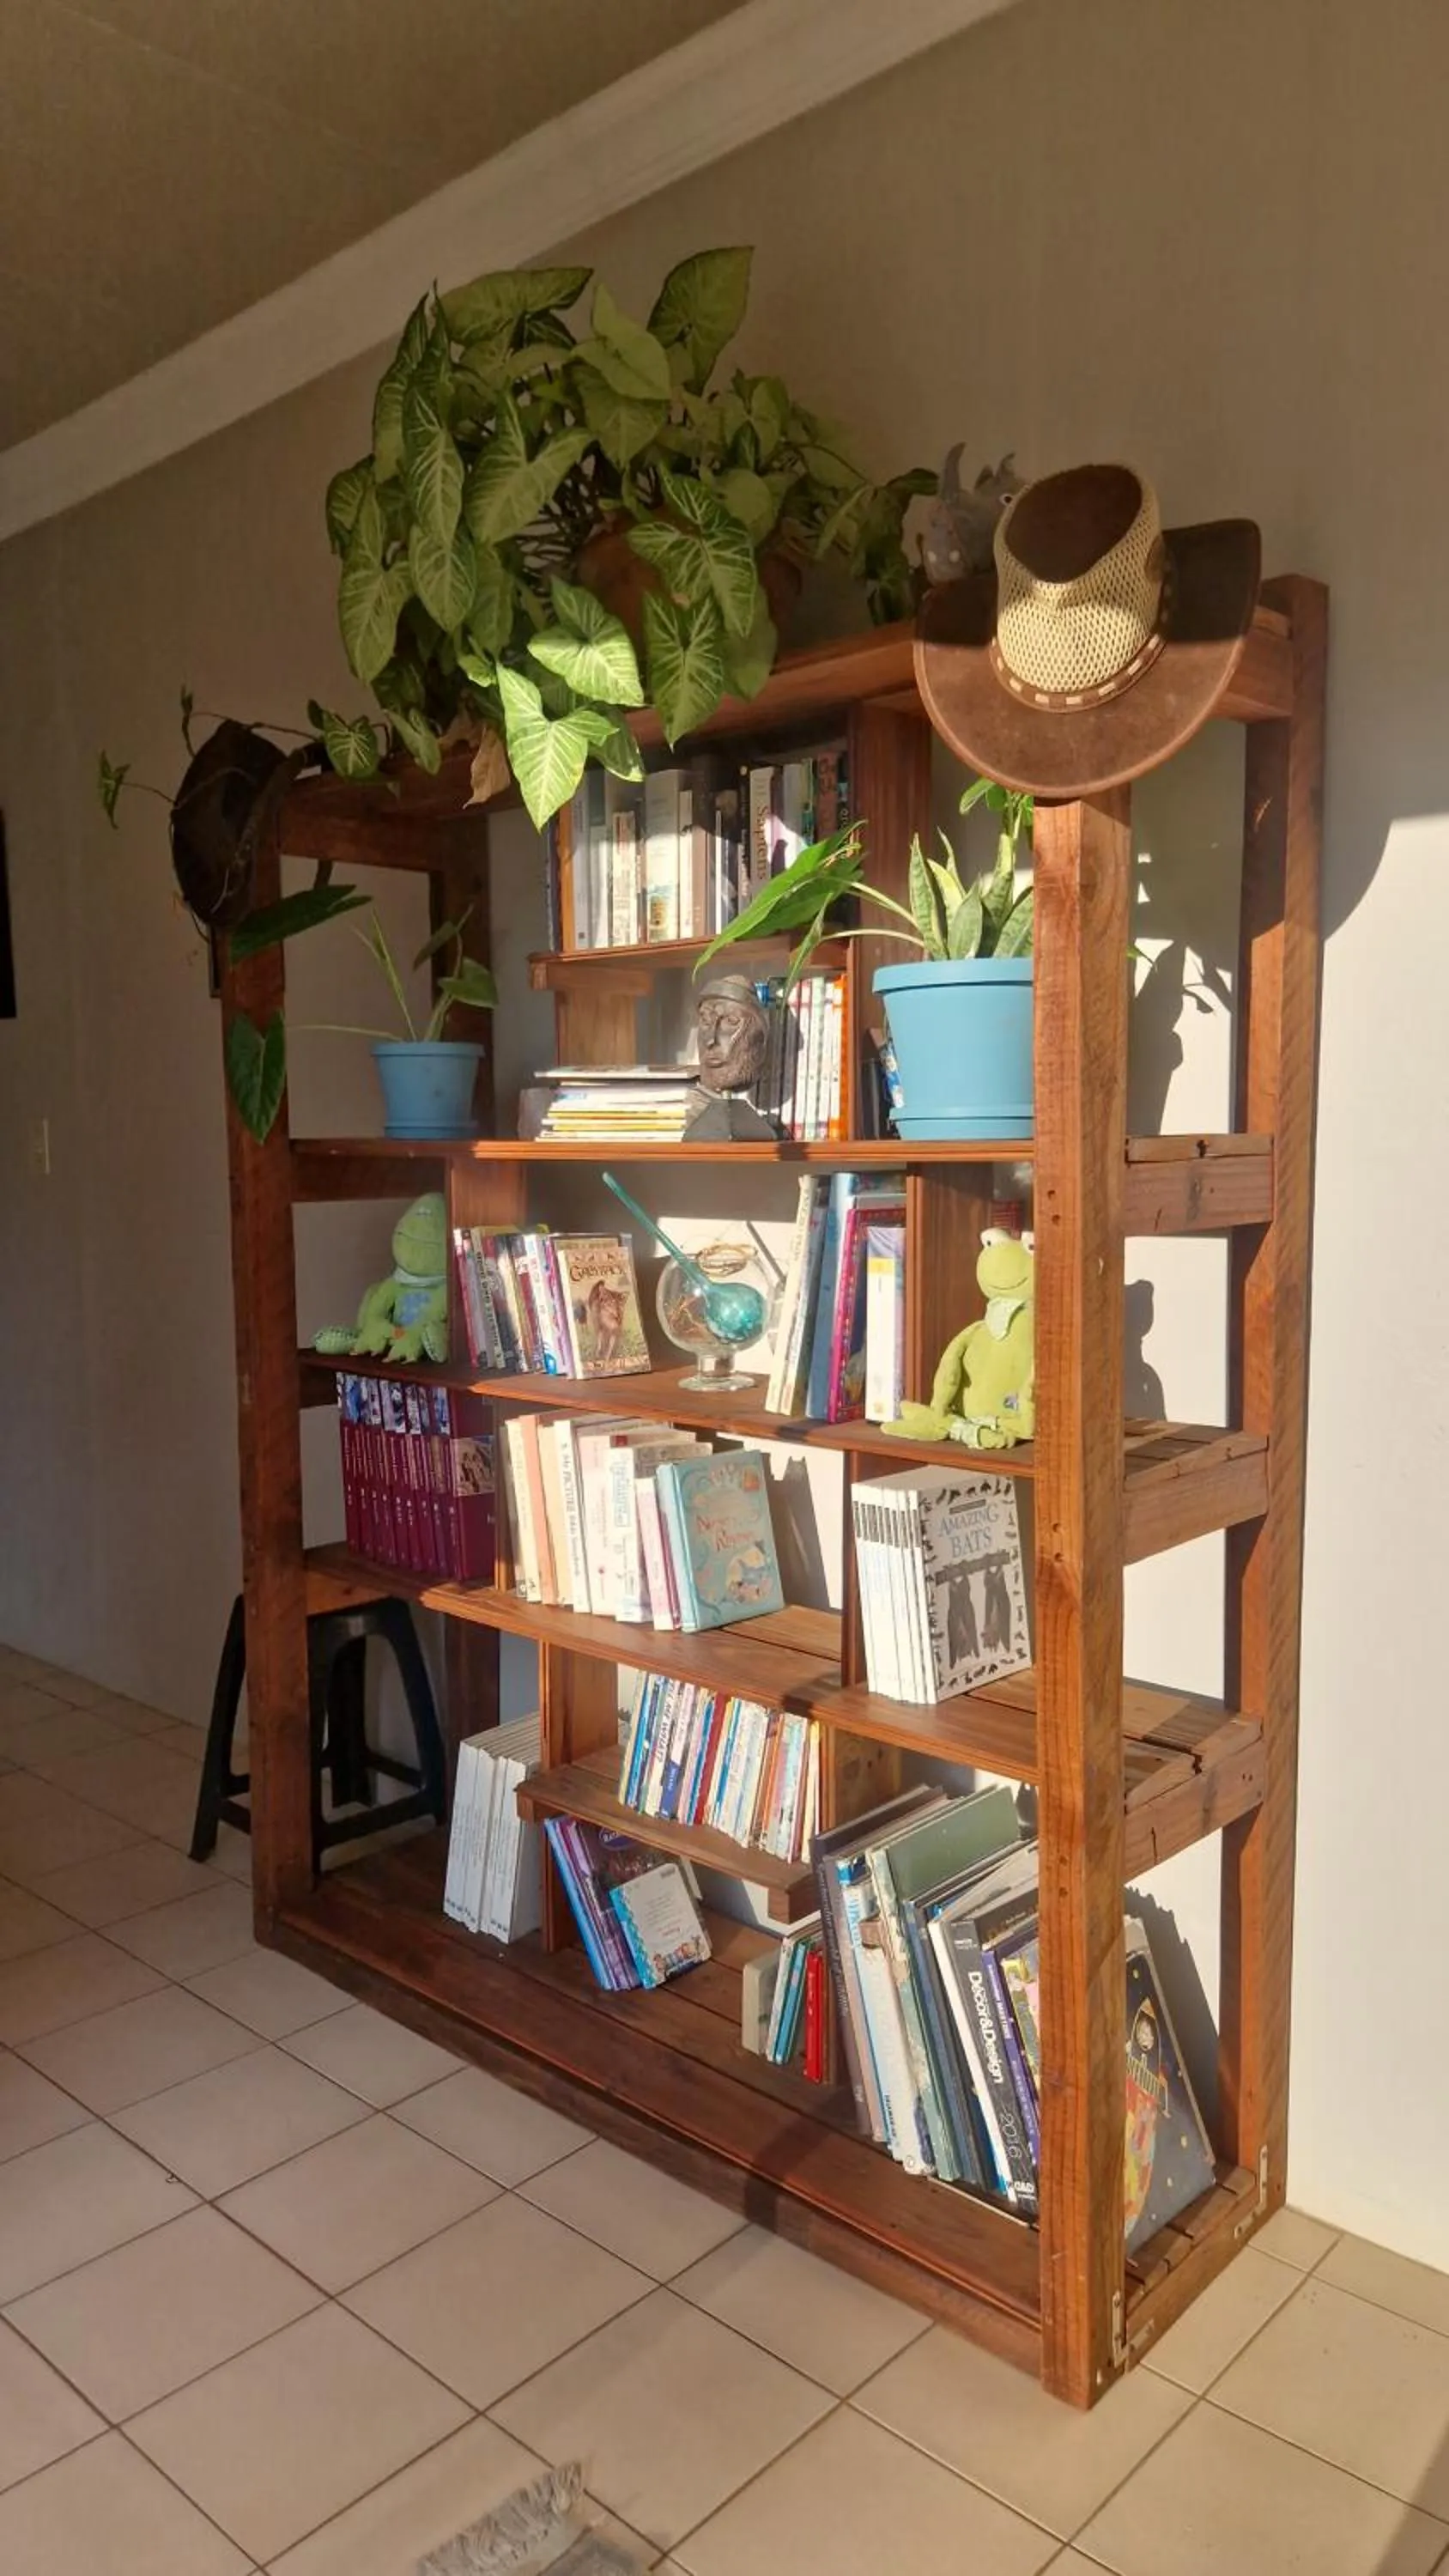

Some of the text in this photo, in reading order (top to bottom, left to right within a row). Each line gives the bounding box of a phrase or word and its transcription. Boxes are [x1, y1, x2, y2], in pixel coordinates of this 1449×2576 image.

[754, 805, 767, 879] Sapiens
[938, 1503, 999, 1537] AMAZING
[949, 1526, 991, 1558] BATS
[1000, 2111, 1022, 2159] 2016
